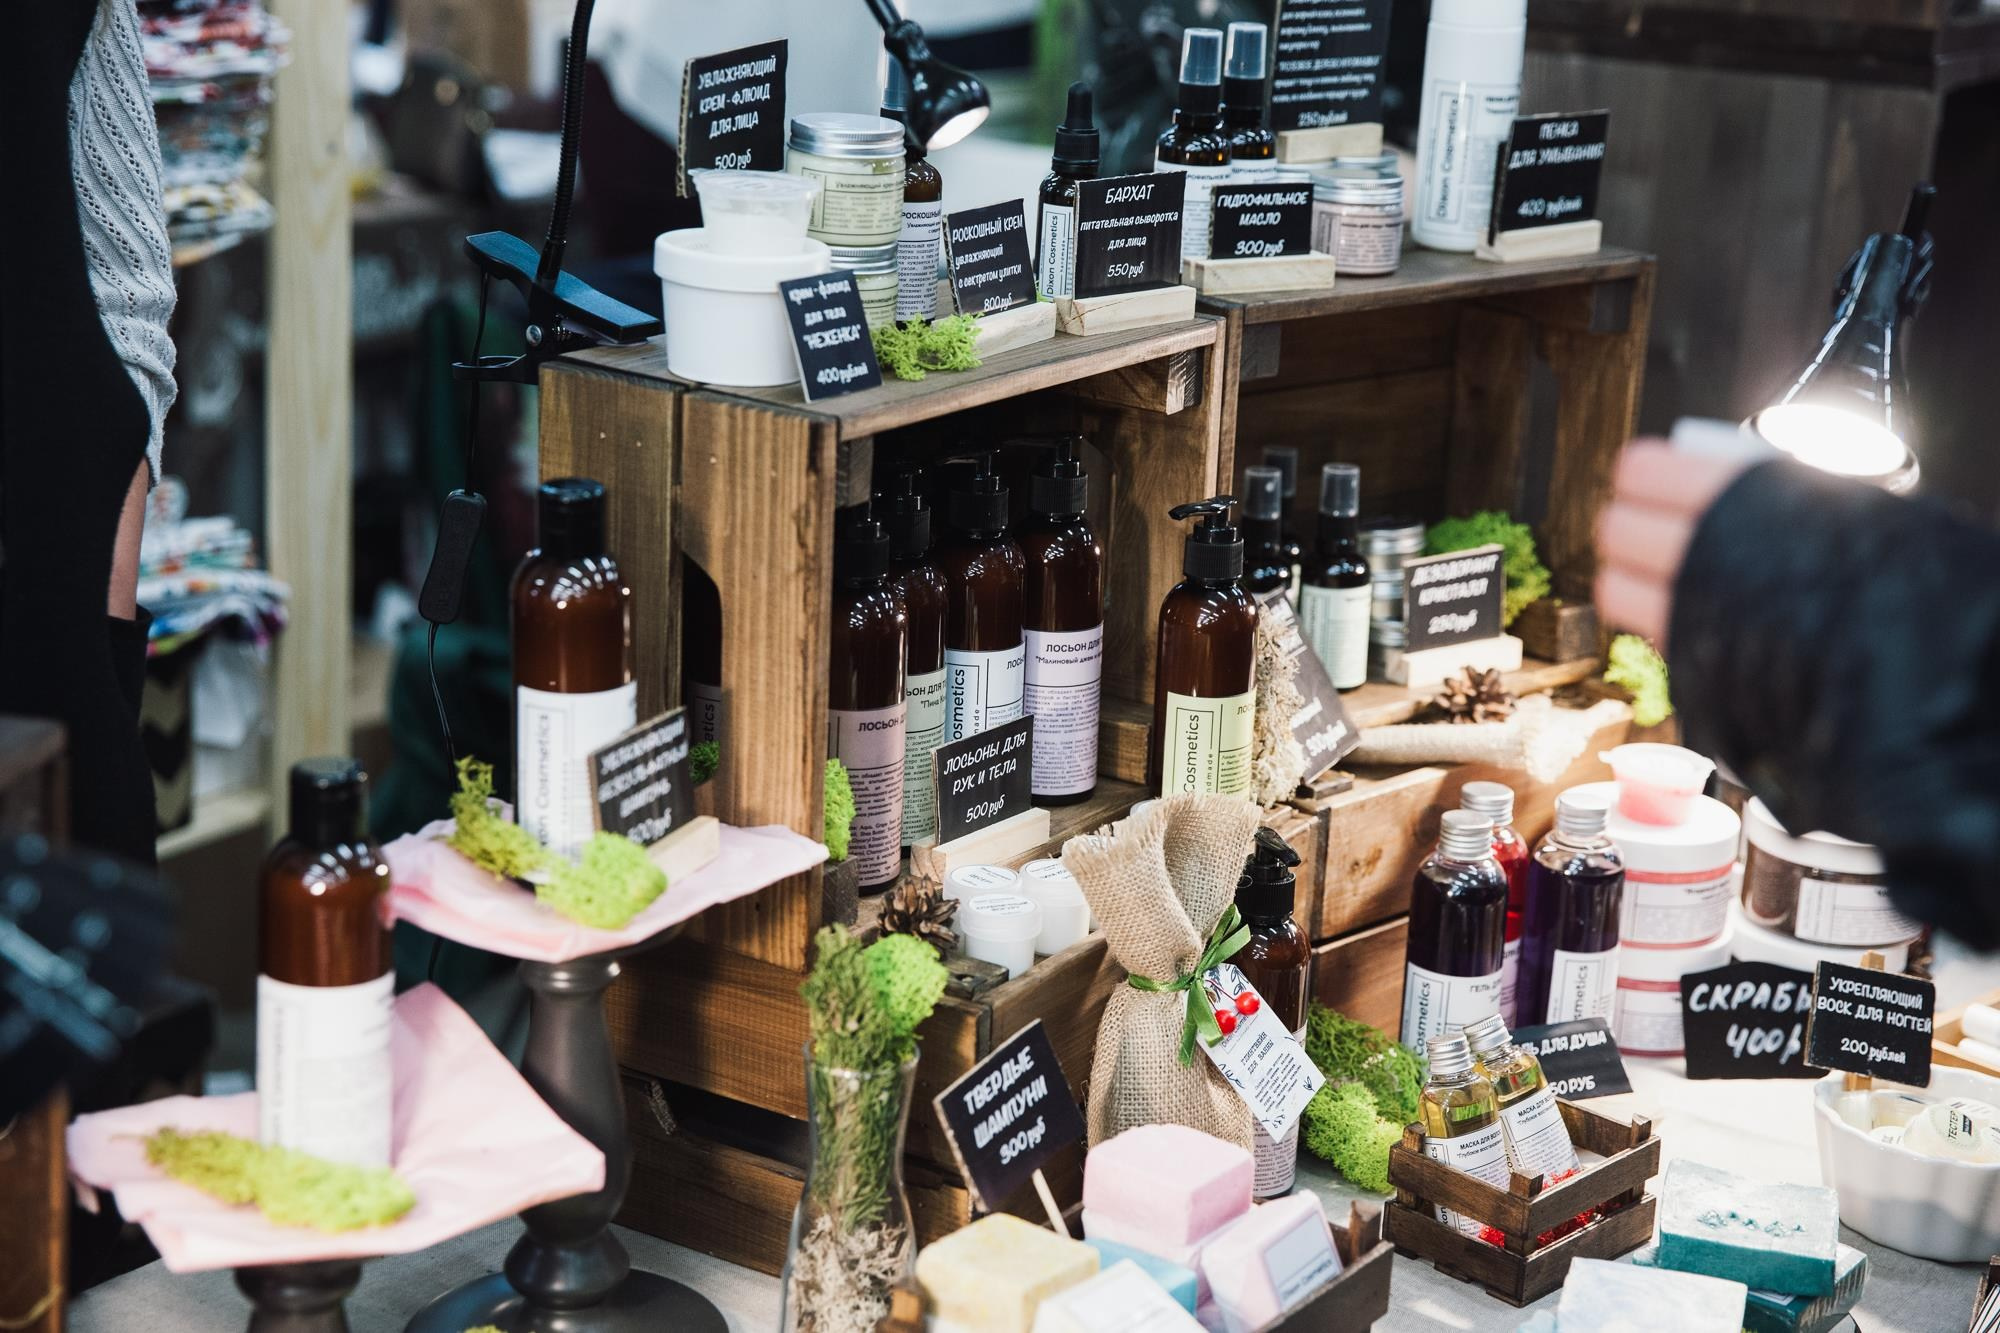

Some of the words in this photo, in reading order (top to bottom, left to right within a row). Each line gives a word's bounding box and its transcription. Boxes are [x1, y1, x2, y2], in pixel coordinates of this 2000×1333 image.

[698, 55, 776, 90] УВЛАЖНЯЮЩИЙ
[700, 93, 726, 114] КРЕМ
[731, 83, 770, 105] ФЛЮИД
[709, 118, 732, 139] ДЛЯ
[732, 111, 758, 132] ЛИЦА
[1538, 121, 1580, 141] ПЕНКА
[715, 152, 736, 170] 500
[1508, 149, 1537, 170] ДЛЯ
[1105, 184, 1155, 204] БАРХАТ
[1217, 191, 1309, 209] ГИДРОФИЛЬНОЕ
[952, 217, 1002, 244] РОСКОШНЫЙ
[1003, 214, 1024, 232] КРЕМ
[1080, 217, 1134, 231] питательная
[1134, 211, 1179, 227] сыворотка
[1239, 212, 1281, 226] МАСЛО
[1049, 215, 1059, 265] Cosmetics
[1107, 239, 1125, 251] для
[1125, 235, 1147, 248] лица
[1234, 240, 1264, 255] 300
[1263, 239, 1285, 257] руб
[955, 243, 1004, 270] увлажняющий
[998, 264, 1022, 282] улитки
[1107, 263, 1129, 278] 550
[1129, 261, 1145, 279] руб
[1046, 272, 1055, 295] Dixon
[983, 296, 1001, 313] 800
[816, 366, 840, 384] 400
[1046, 642, 1087, 653] ЛОСЬОН
[950, 668, 966, 742] osmetics
[858, 718, 899, 732] ЛОСЬОН
[944, 739, 1000, 775] ЛОСЬОНЫ
[1001, 731, 1028, 756] ДЛЯ
[1183, 714, 1200, 793] Cosmetics
[952, 774, 976, 796] РУК
[976, 771, 986, 786] И
[988, 758, 1017, 783] ТЕЛА
[965, 801, 989, 824] 500
[987, 794, 1006, 819] руб
[1829, 976, 1923, 1010] УКРЕПЛЯЮЩИЙ
[1817, 996, 1852, 1016] ВОСК
[1854, 1004, 1884, 1023] ДЛЯ
[1886, 1011, 1932, 1034] НОГТЕЙ
[1240, 1031, 1268, 1067] ГЛИНТВЕЙН
[1540, 1037, 1569, 1056] ДЛЯ
[1568, 1030, 1608, 1052] ДУША
[1840, 1037, 1869, 1055] 200
[1868, 1046, 1906, 1064] рублей
[963, 1045, 1035, 1115] ТВЕРДЫЕ
[1568, 1075, 1597, 1094] РУБ
[973, 1075, 1049, 1149] ШАМПУНИ
[1517, 1105, 1536, 1118] МАСКА
[999, 1130, 1028, 1166] 300
[1026, 1115, 1047, 1149] руб
[1460, 1139, 1480, 1151] МАСКА
[1480, 1135, 1491, 1146] ДЛЯ
[1457, 1148, 1479, 1160] "Глубокое
